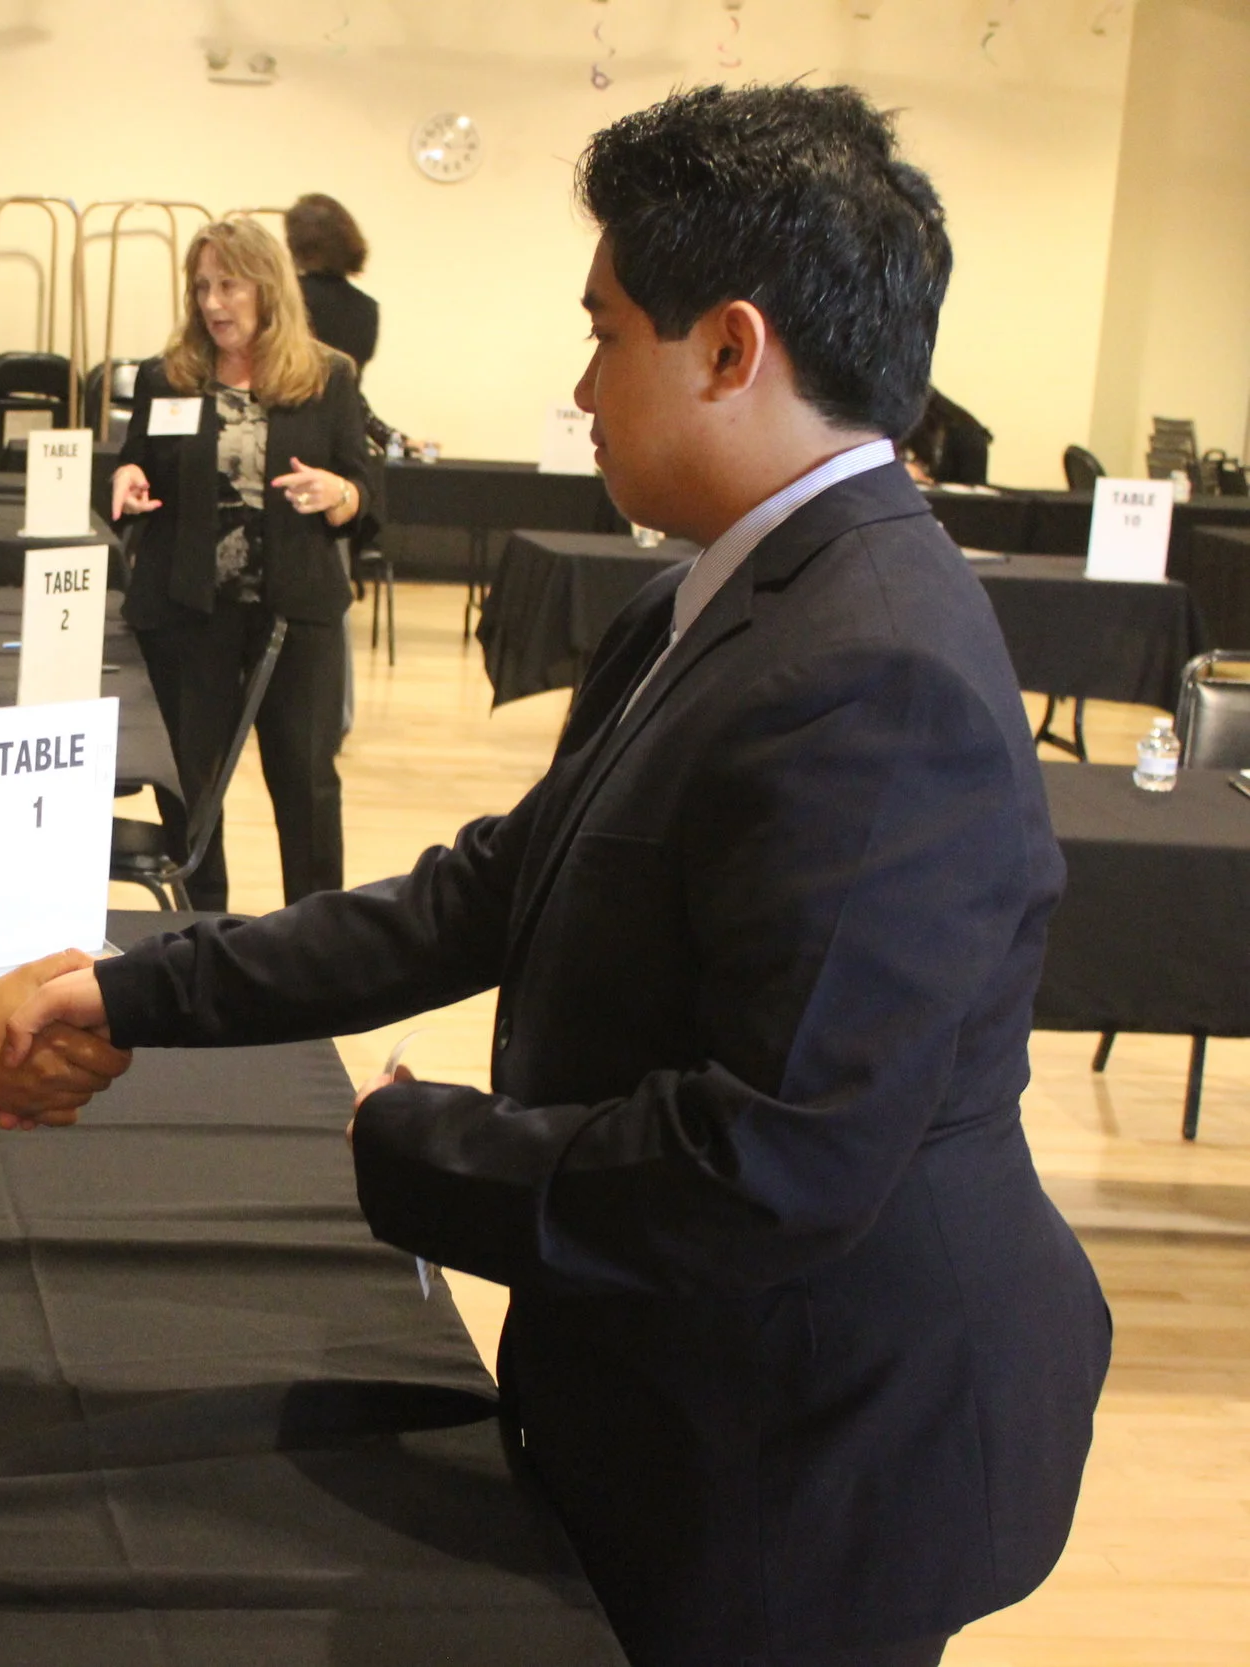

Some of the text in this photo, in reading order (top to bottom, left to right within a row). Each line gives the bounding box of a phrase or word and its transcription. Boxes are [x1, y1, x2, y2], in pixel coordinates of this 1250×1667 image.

[43, 443, 78, 458] TABLE
[56, 466, 63, 480] 3
[1113, 492, 1156, 506] TABLE
[1124, 515, 1141, 527] 10
[45, 569, 91, 595] TABLE
[61, 609, 70, 631] 2
[33, 796, 43, 828] 1
